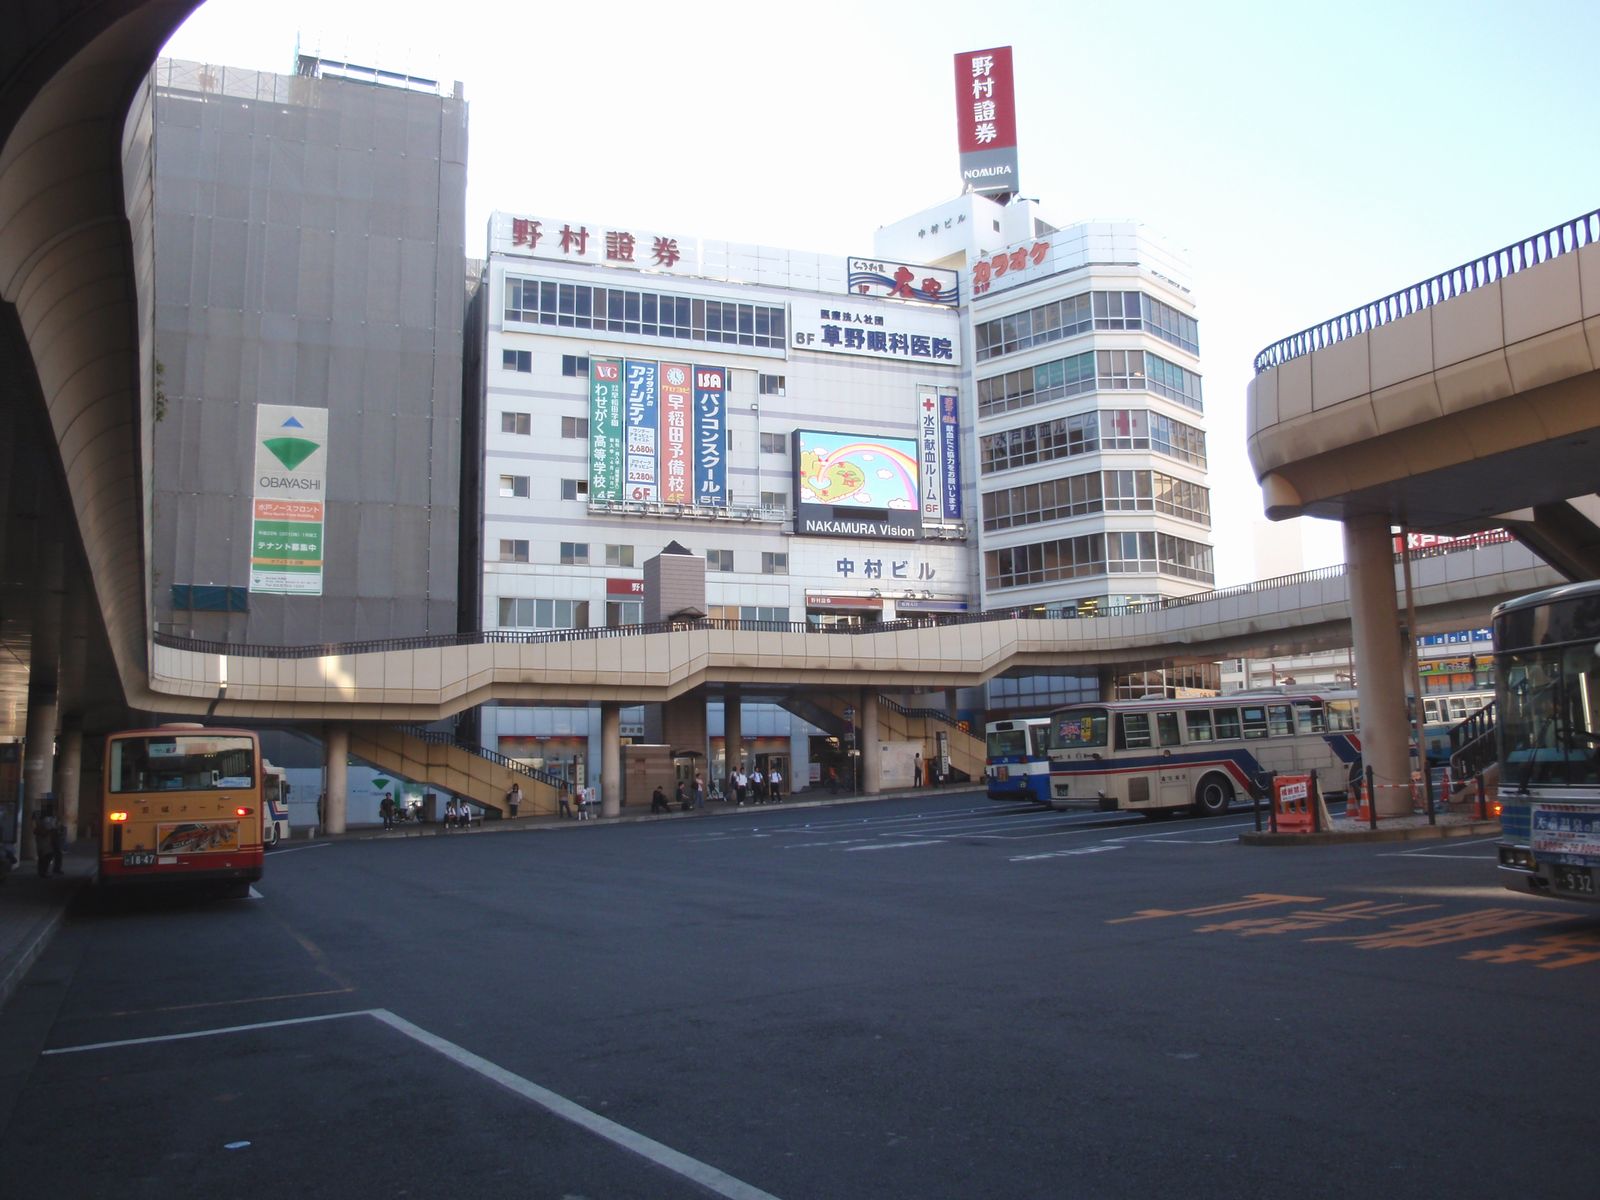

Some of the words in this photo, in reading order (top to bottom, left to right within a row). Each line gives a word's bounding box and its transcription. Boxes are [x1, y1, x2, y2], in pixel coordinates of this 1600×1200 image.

[971, 55, 997, 144] 野村證券
[964, 165, 1012, 178] NOMURA
[918, 214, 966, 239] 中村ビル
[512, 217, 681, 268] 野村證券
[973, 242, 1050, 285] カラオケ
[821, 324, 953, 360] 草野眼科医院
[628, 365, 645, 425] アイシティ
[697, 374, 722, 389] ISA
[593, 383, 608, 488] わせがく高等学校
[667, 394, 686, 492] 早稲田予備校
[923, 414, 938, 501] 水戸献血ルーム
[260, 476, 321, 490] OBAYASHI
[632, 487, 651, 500] 6F
[925, 504, 939, 513] 6F
[806, 520, 876, 535] NAKAMURA
[880, 524, 915, 537] Vision
[836, 558, 936, 580] 中村ビル
